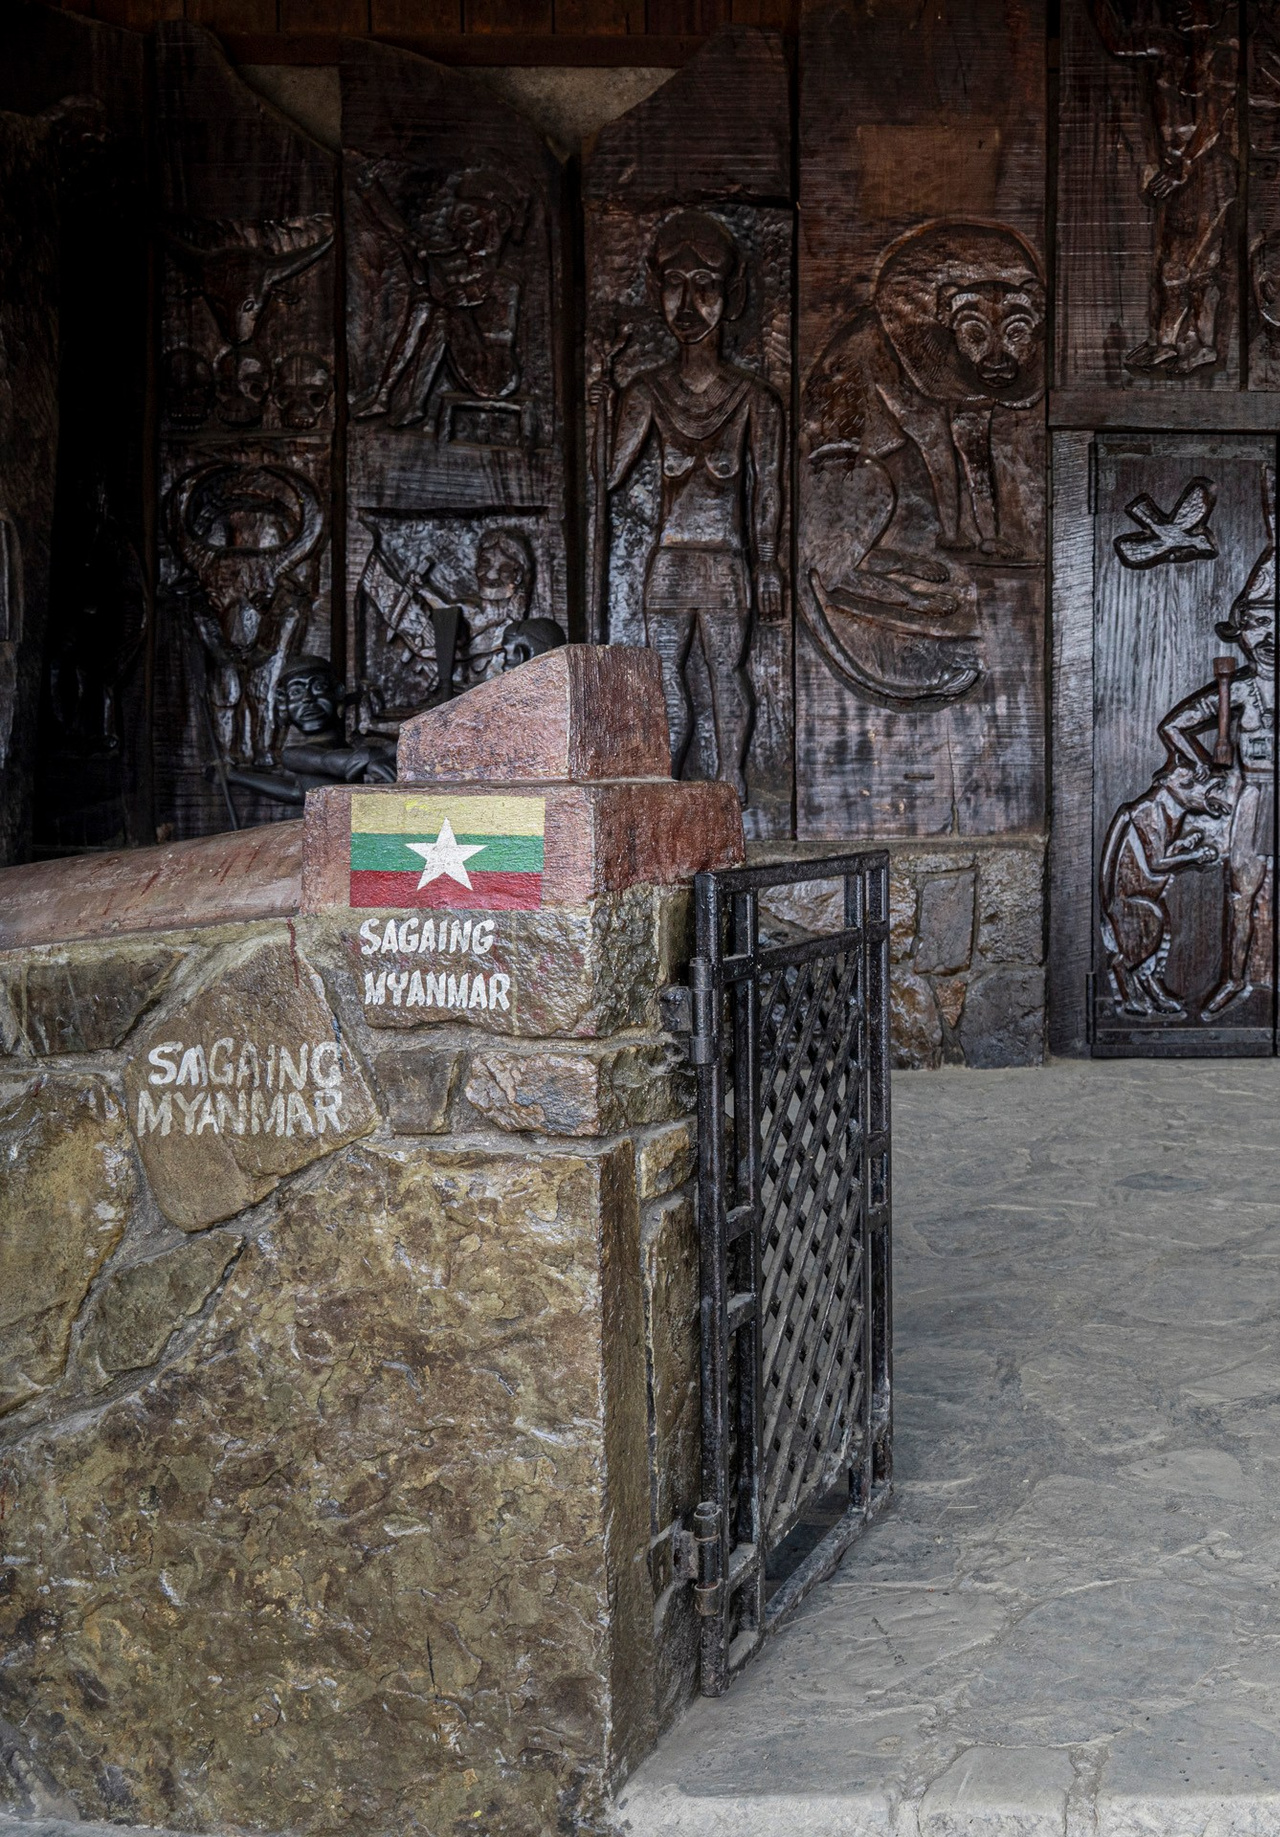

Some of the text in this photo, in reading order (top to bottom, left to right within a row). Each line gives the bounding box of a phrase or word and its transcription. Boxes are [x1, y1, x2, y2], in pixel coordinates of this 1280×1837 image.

[359, 917, 495, 955] SAGAING
[364, 971, 511, 1010] MYANMAR
[148, 1037, 345, 1088] SAGAING
[137, 1090, 347, 1137] MYANMAR
